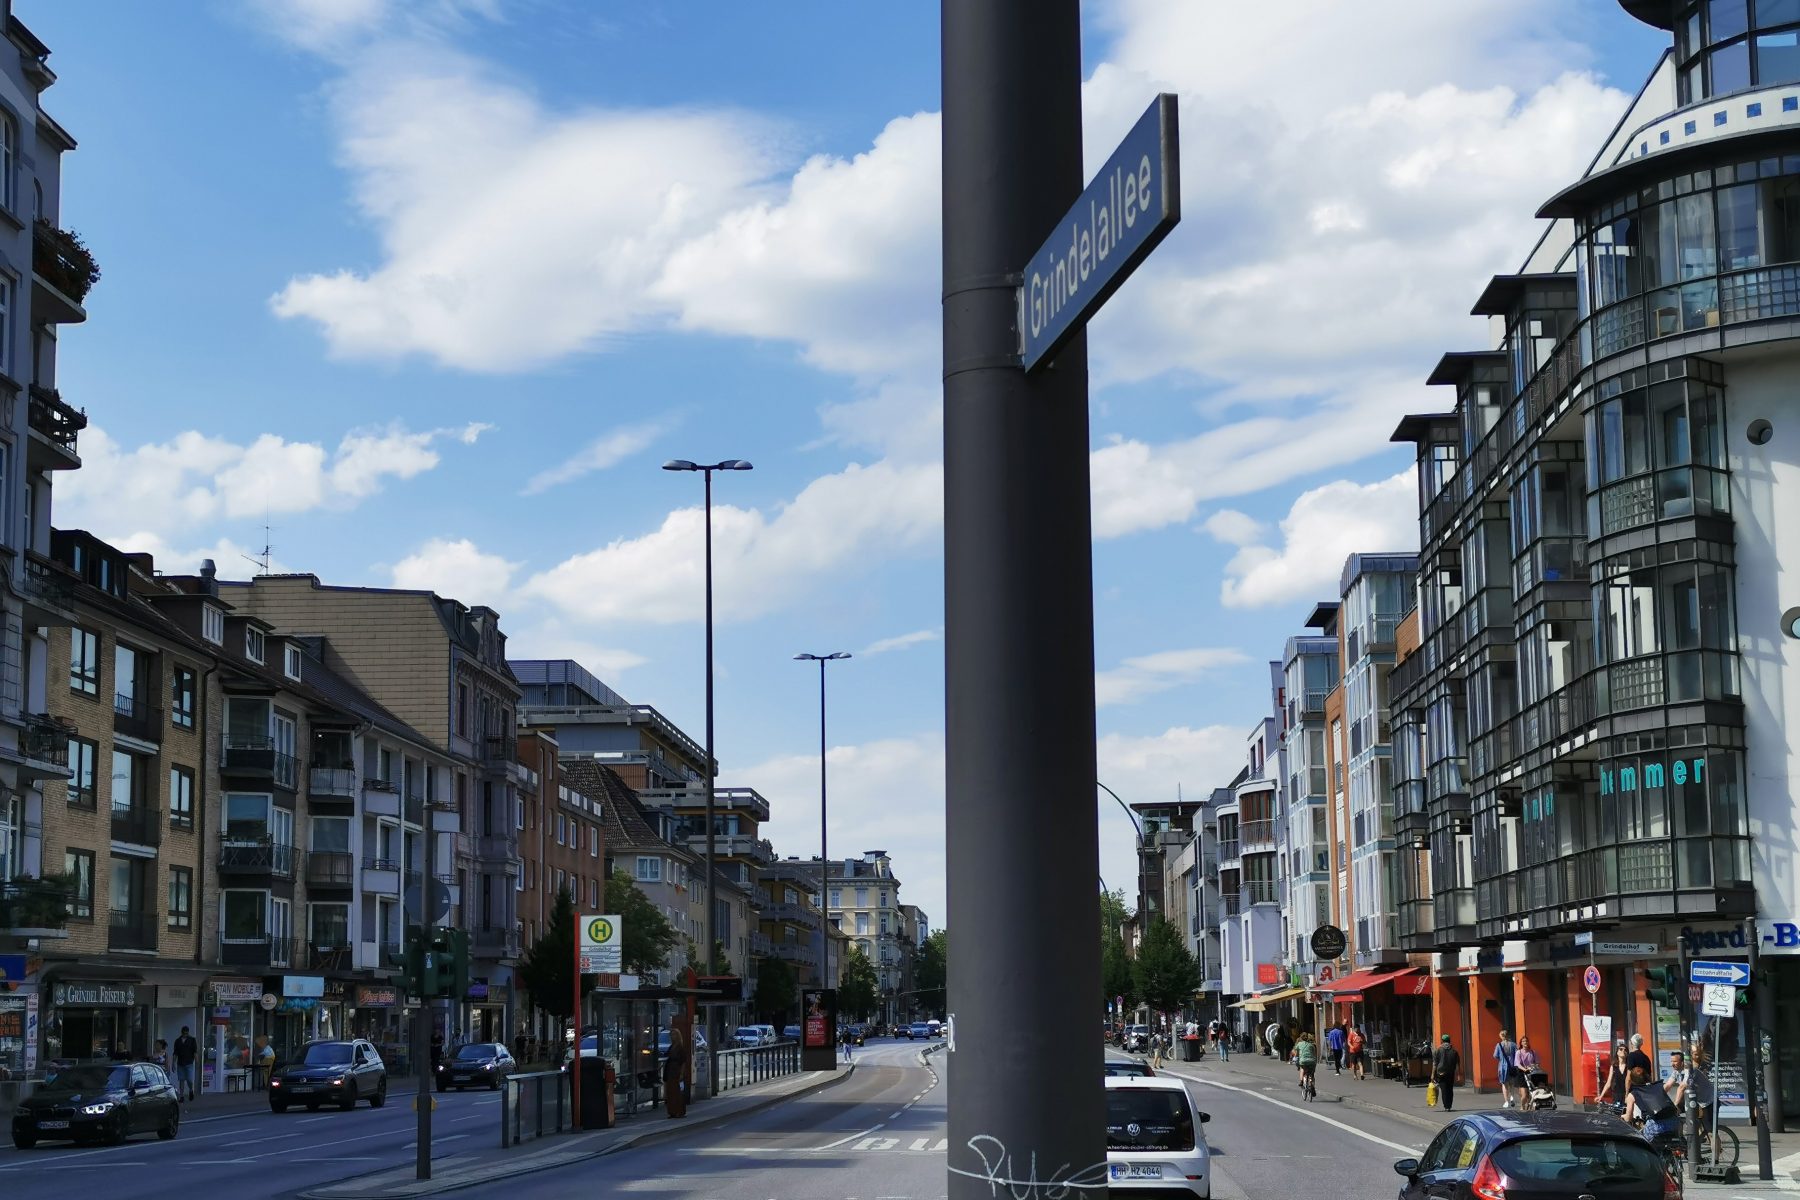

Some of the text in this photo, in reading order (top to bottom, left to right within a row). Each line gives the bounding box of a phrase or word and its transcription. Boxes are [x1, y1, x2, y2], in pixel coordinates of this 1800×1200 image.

[1030, 154, 1151, 339] Grindelallee
[594, 923, 607, 938] H
[1116, 1166, 1127, 1176] HH
[1142, 1166, 1161, 1176] 4044
